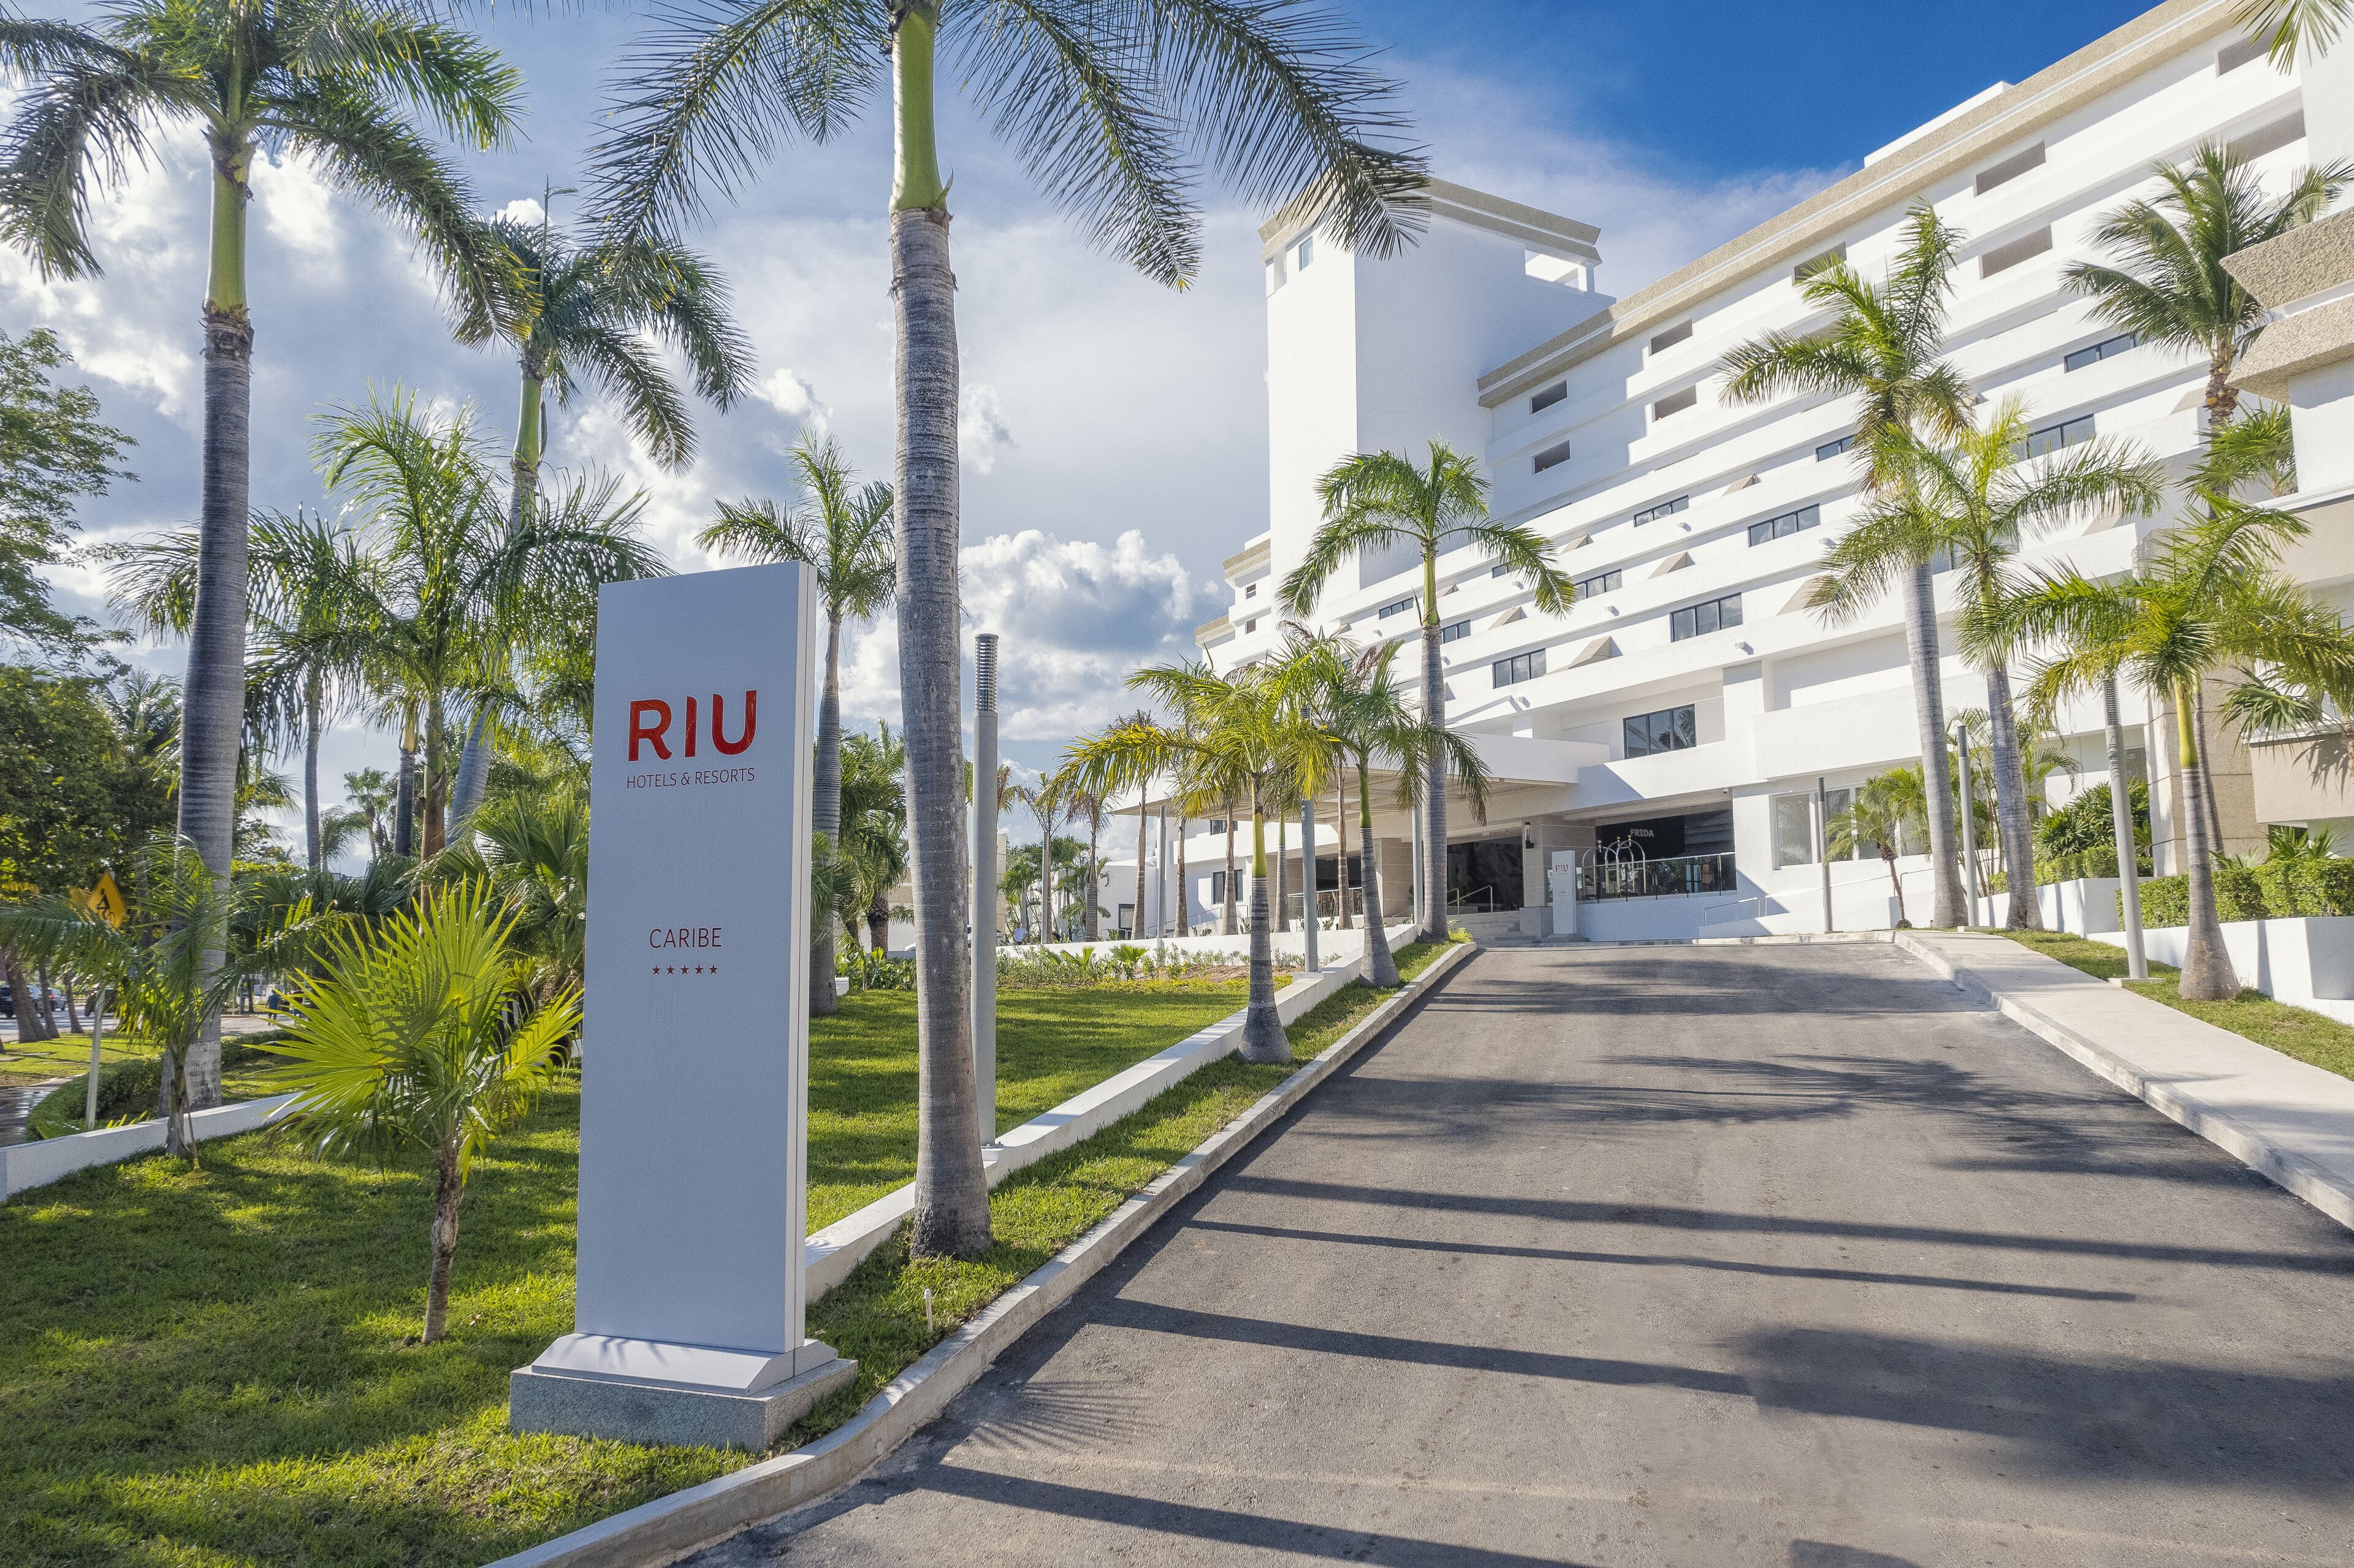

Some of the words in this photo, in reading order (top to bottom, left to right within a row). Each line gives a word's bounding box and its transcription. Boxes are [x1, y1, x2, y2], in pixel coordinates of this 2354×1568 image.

[628, 690, 758, 762] RIU
[627, 772, 677, 789] HOTELS
[680, 772, 691, 786] &
[695, 767, 755, 785] RESORTS
[1631, 829, 1654, 837] FRIDA
[649, 927, 722, 949] CARIBE
